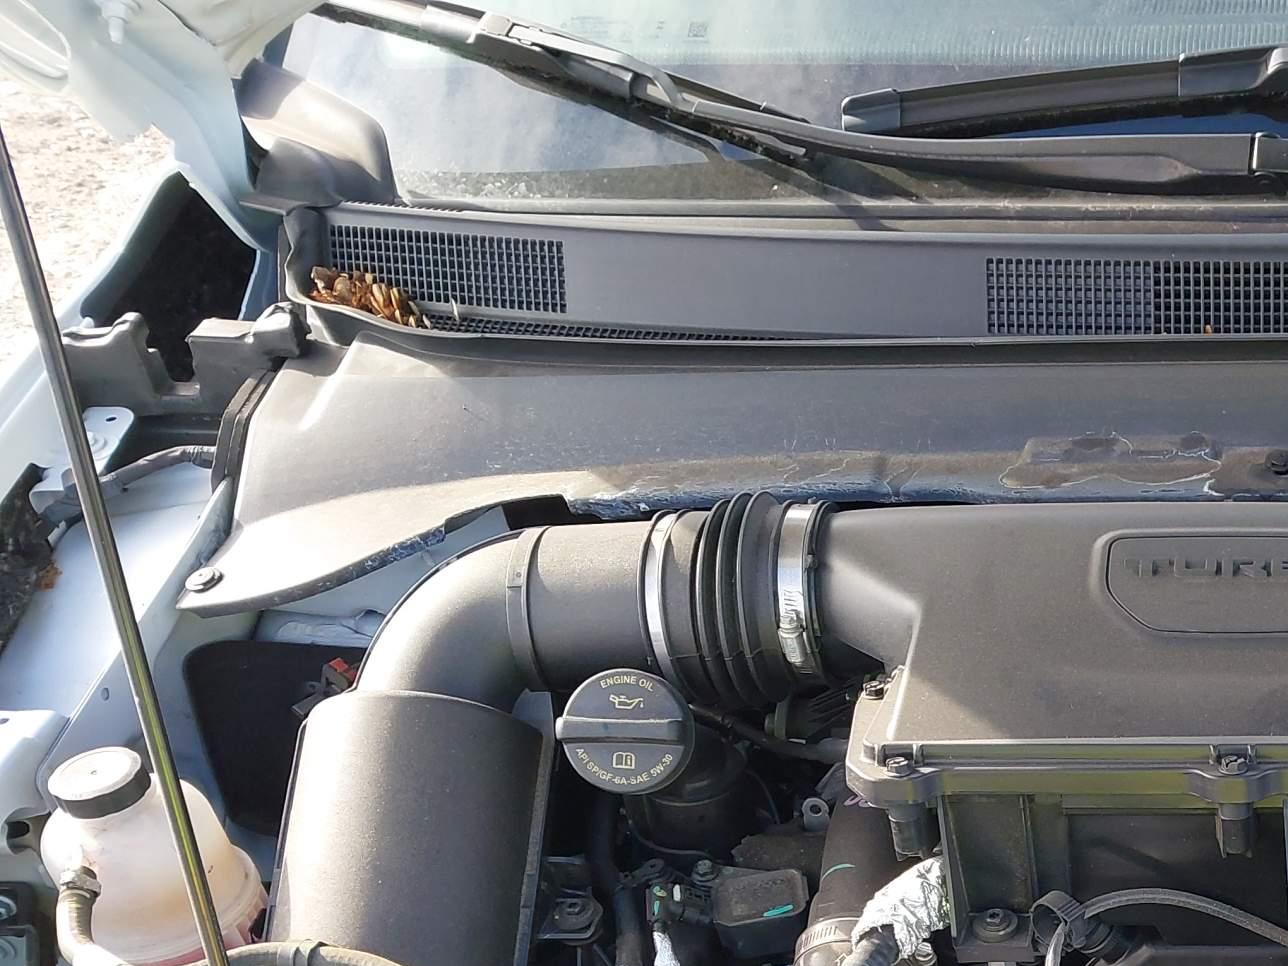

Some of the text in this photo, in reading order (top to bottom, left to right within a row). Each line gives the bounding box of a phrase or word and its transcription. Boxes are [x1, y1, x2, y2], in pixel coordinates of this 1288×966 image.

[599, 675, 654, 692] ENGINE OIL
[575, 748, 588, 763] API
[650, 753, 674, 777] 5W-30
